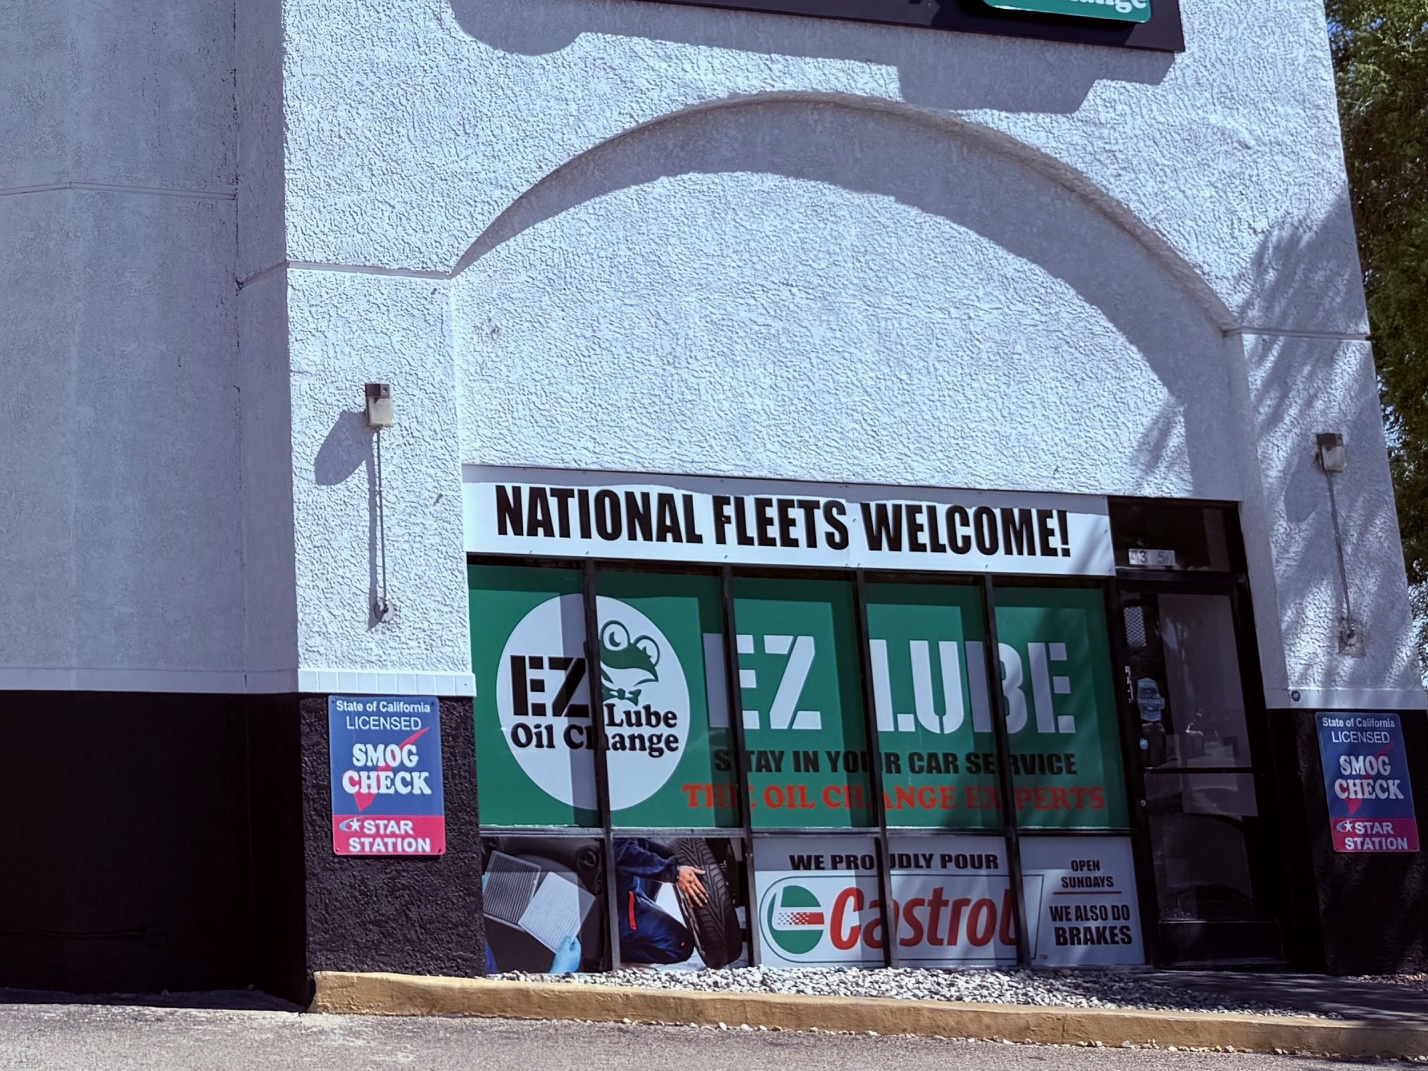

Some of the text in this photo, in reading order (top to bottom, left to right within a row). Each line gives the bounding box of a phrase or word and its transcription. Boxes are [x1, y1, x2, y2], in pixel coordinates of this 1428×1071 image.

[495, 484, 1071, 557] NATIONAL FLEETS WELCOME!
[510, 655, 590, 718] EZ
[702, 632, 822, 730] EZ
[869, 638, 1076, 734] LUBE
[336, 700, 431, 713] State of California
[603, 703, 677, 729] Lube
[346, 716, 422, 731] LICENSED
[1322, 717, 1395, 728] State of California
[510, 722, 555, 749] Oil
[1331, 731, 1390, 744] LICENSED
[352, 743, 419, 768] SMOG
[792, 750, 820, 773] IN
[908, 751, 959, 775] CAR
[965, 752, 1077, 776] SERVICE
[1339, 755, 1391, 776] SMOG
[341, 770, 432, 795] CHECK
[1334, 778, 1405, 800] CHECK
[763, 785, 816, 810] OIL
[823, 785, 957, 811] CHANGE
[964, 785, 1106, 811] EXPERTS
[363, 820, 414, 835] STAR
[1354, 822, 1395, 835] STAR
[348, 837, 431, 853] STATION
[1344, 837, 1408, 850] STATION
[788, 854, 825, 870] WE
[940, 853, 999, 869] POUR
[1070, 859, 1100, 872] OPEN
[1061, 876, 1114, 888] SUNDAYS
[830, 886, 1017, 951] Castrol
[1049, 904, 1130, 922] WE ALSO DO
[1054, 925, 1132, 946] BRAKES
